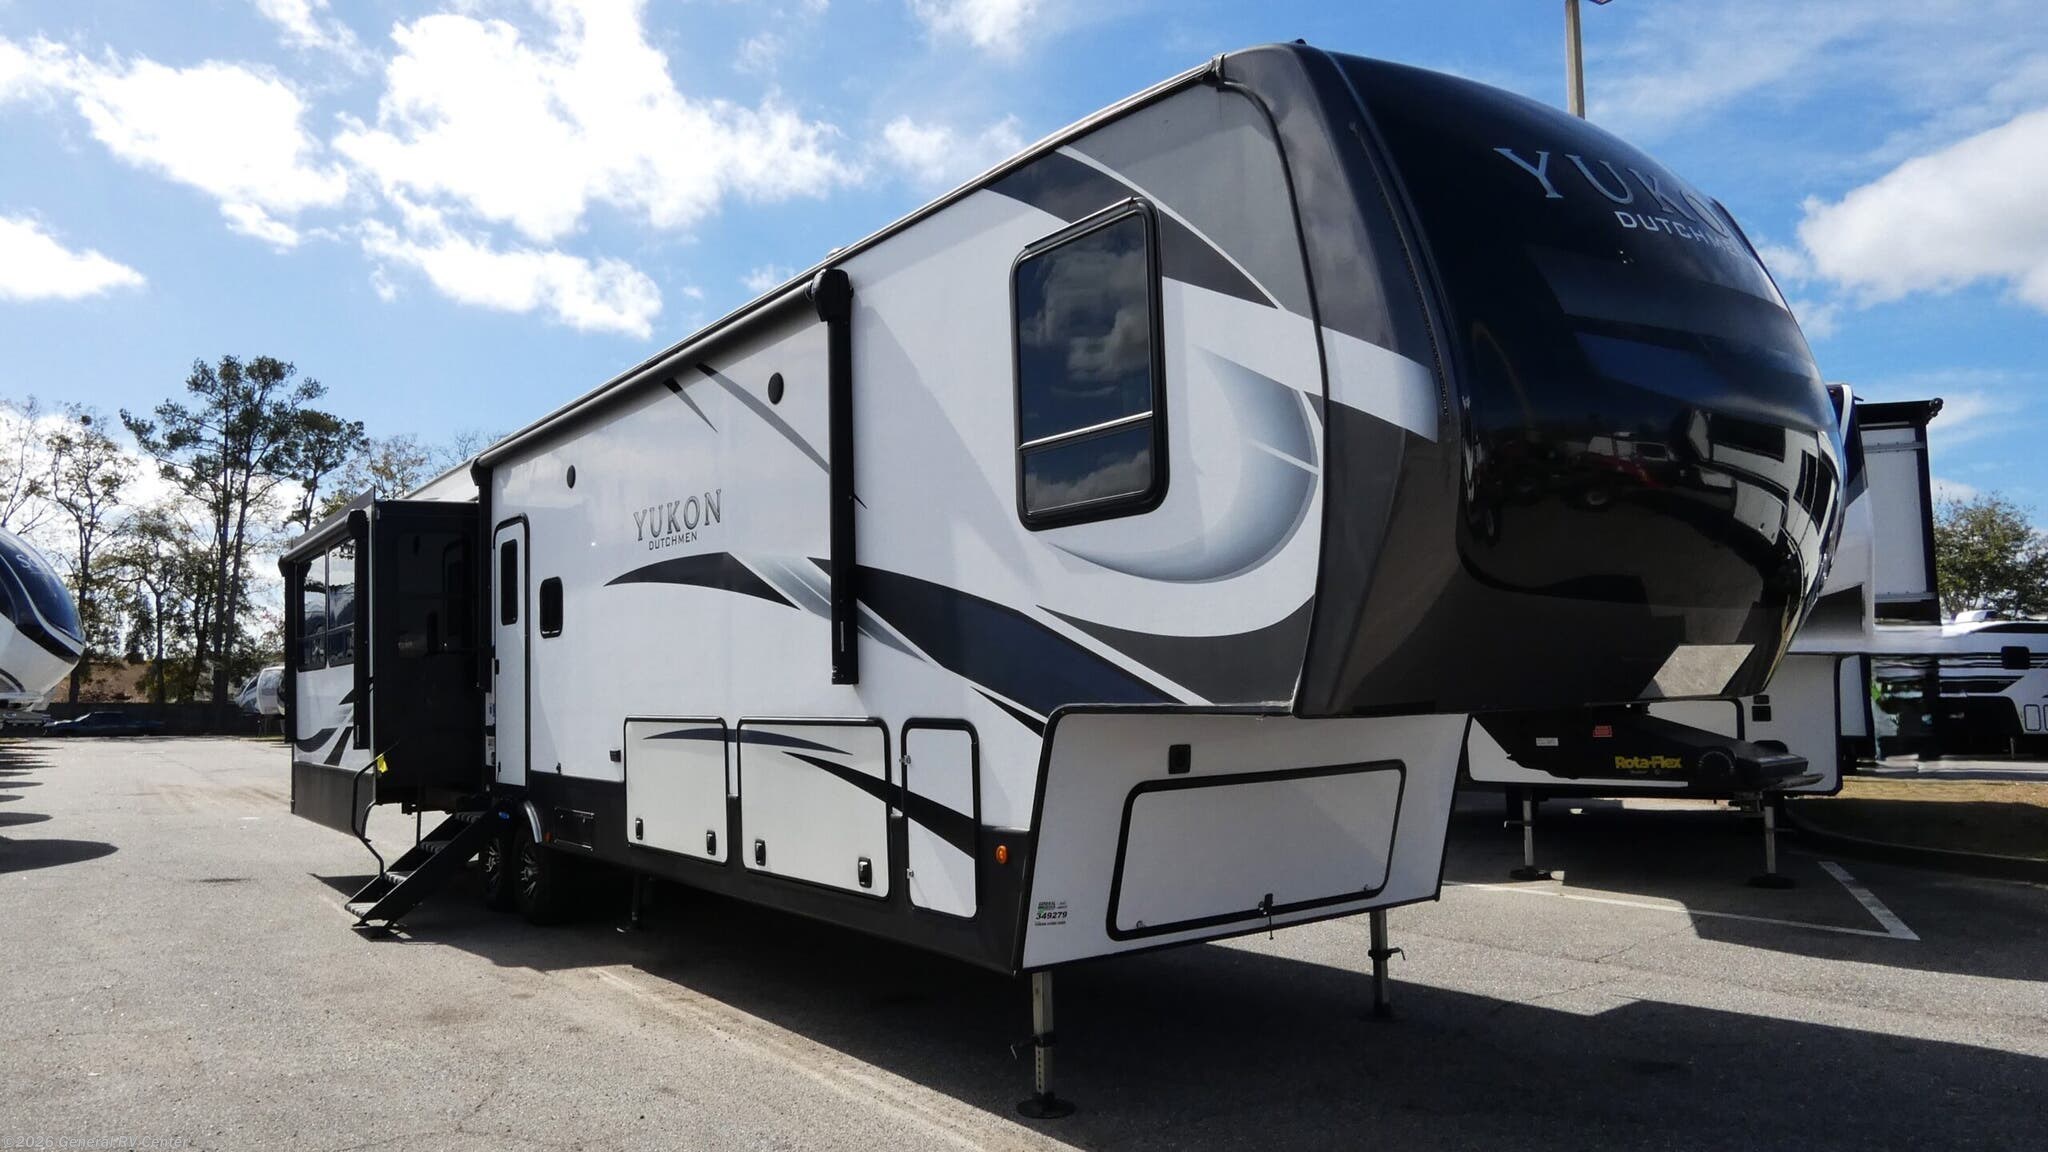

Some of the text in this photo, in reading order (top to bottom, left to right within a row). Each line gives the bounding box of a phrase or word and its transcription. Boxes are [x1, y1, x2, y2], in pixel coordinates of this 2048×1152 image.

[1493, 147, 1730, 239] YUKO
[633, 488, 722, 541] YUKON
[648, 531, 697, 550] DUTCHMEN
[1035, 911, 1068, 920] 349279
